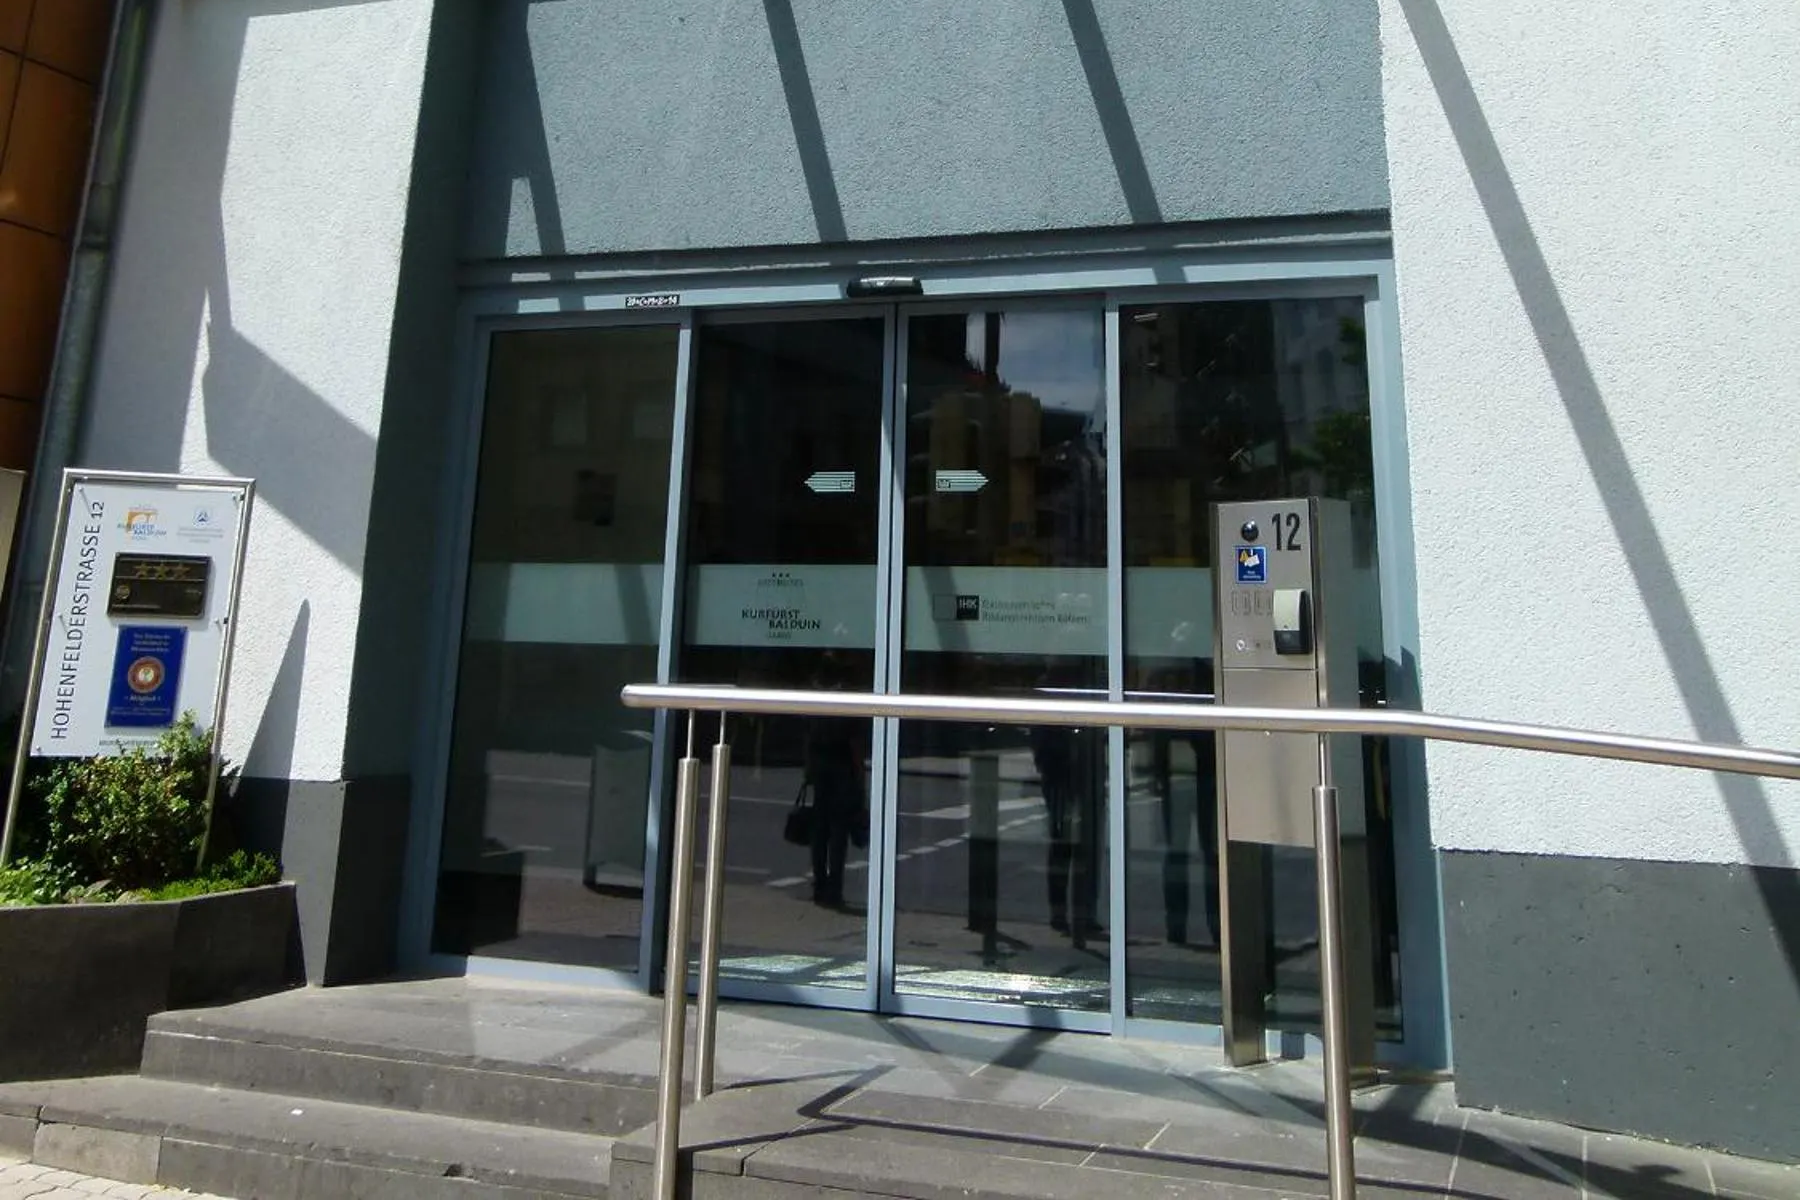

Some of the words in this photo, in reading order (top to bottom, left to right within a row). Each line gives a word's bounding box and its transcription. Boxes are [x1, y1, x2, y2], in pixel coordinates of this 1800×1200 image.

[1271, 512, 1301, 551] 12
[959, 598, 977, 610] IHK
[51, 524, 101, 739] HOHENFELDERSTRASSE
[92, 501, 105, 519] 12
[768, 619, 820, 630] BALDUIN
